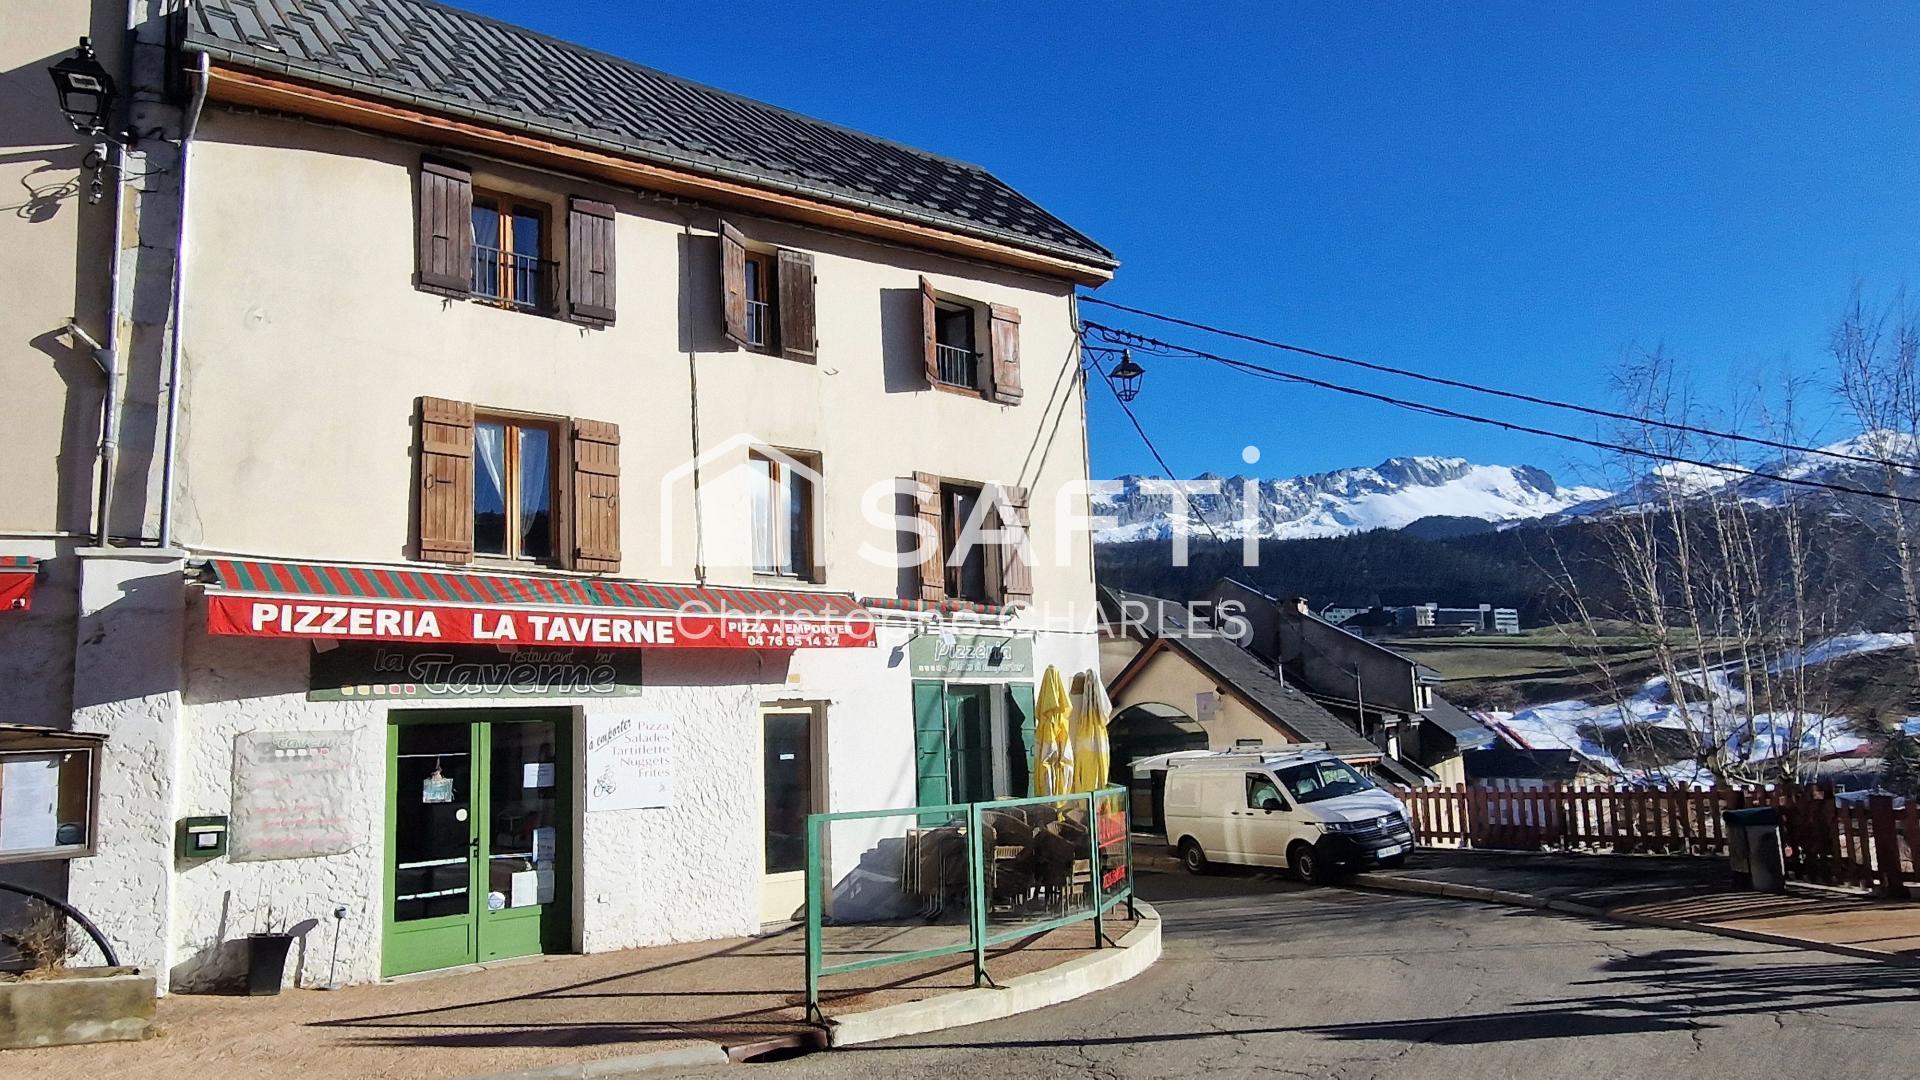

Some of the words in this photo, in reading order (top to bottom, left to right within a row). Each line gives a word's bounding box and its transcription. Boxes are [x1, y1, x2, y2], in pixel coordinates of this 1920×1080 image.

[252, 603, 441, 637] PIZZERIA
[473, 613, 518, 640] LA
[528, 616, 675, 643] TAVERNE
[728, 621, 769, 633] PIZZA
[772, 622, 783, 634] A
[784, 623, 853, 635] EMPORTER
[747, 635, 764, 646] 04
[767, 635, 783, 647] 76
[786, 635, 802, 647] 95
[806, 636, 822, 647] 14
[825, 635, 840, 647] 32
[510, 648, 574, 663] restaurant
[595, 649, 615, 663] bar
[373, 649, 404, 672] la
[408, 653, 616, 694] Taverne
[596, 718, 632, 747] emporter
[638, 721, 670, 731] Pizza
[625, 733, 670, 743] Salades
[621, 757, 670, 769] Nuggets
[638, 768, 670, 777] Frites
